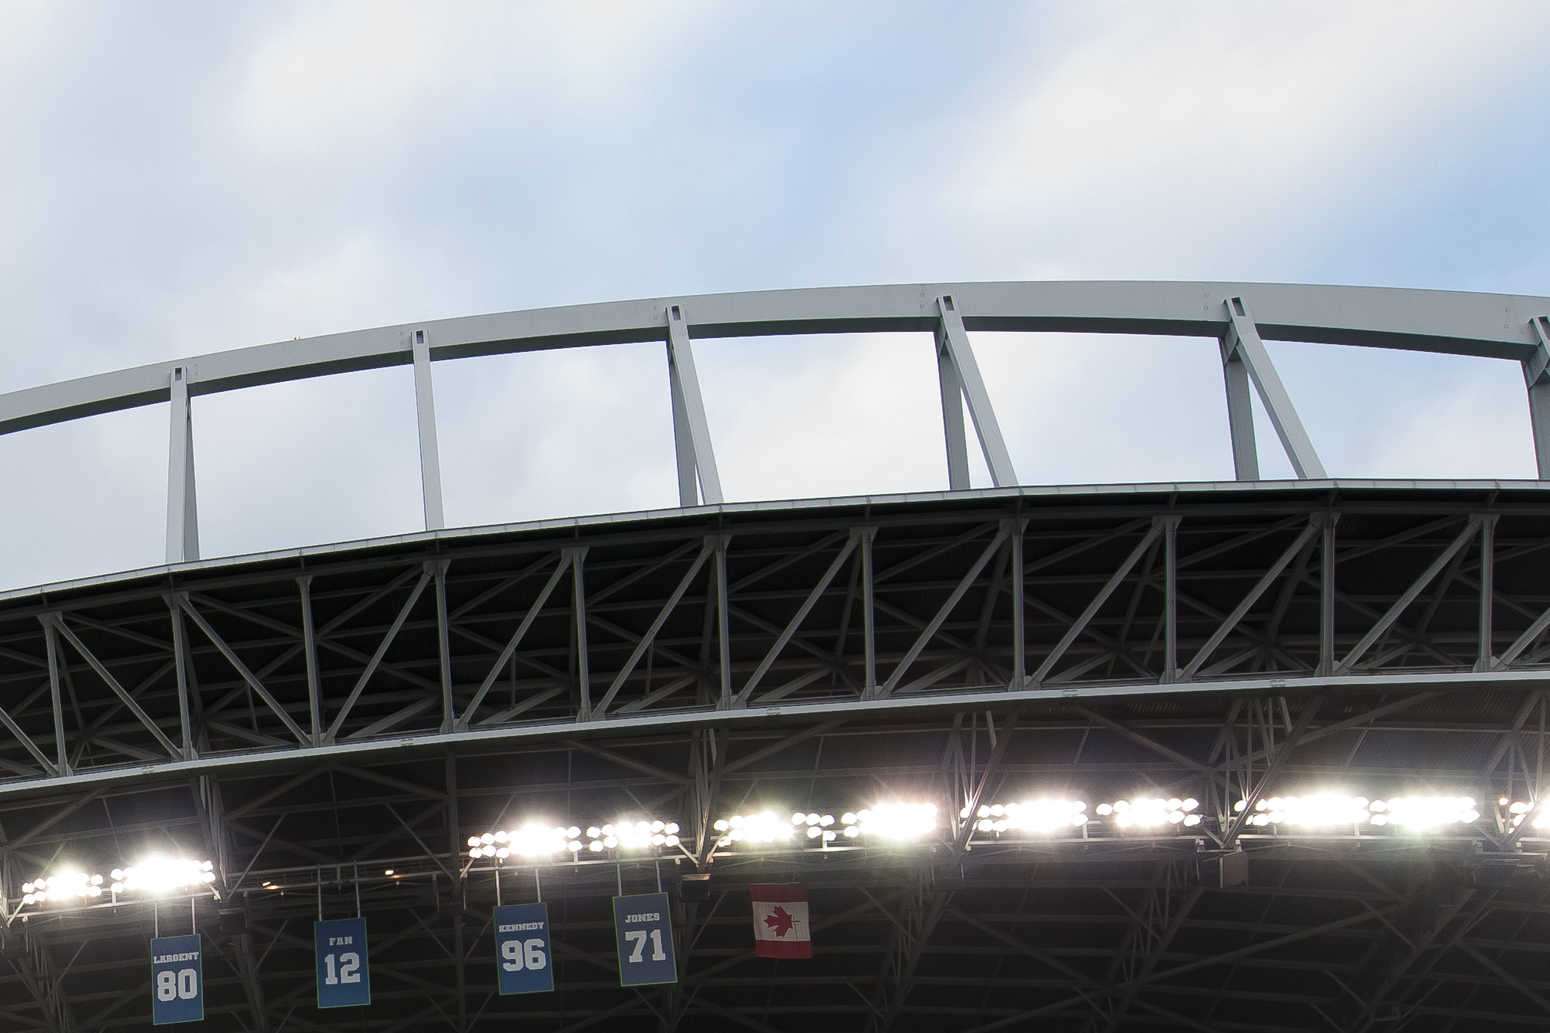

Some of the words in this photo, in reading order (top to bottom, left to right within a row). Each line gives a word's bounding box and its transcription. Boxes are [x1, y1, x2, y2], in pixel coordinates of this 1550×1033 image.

[498, 921, 545, 933] KENNEDY
[624, 912, 661, 924] JONES
[328, 935, 353, 946] FAN
[624, 929, 666, 963] 71
[153, 951, 200, 965] LARGENT
[501, 938, 546, 972] 96
[324, 952, 361, 985] 12
[156, 968, 198, 1002] 80
